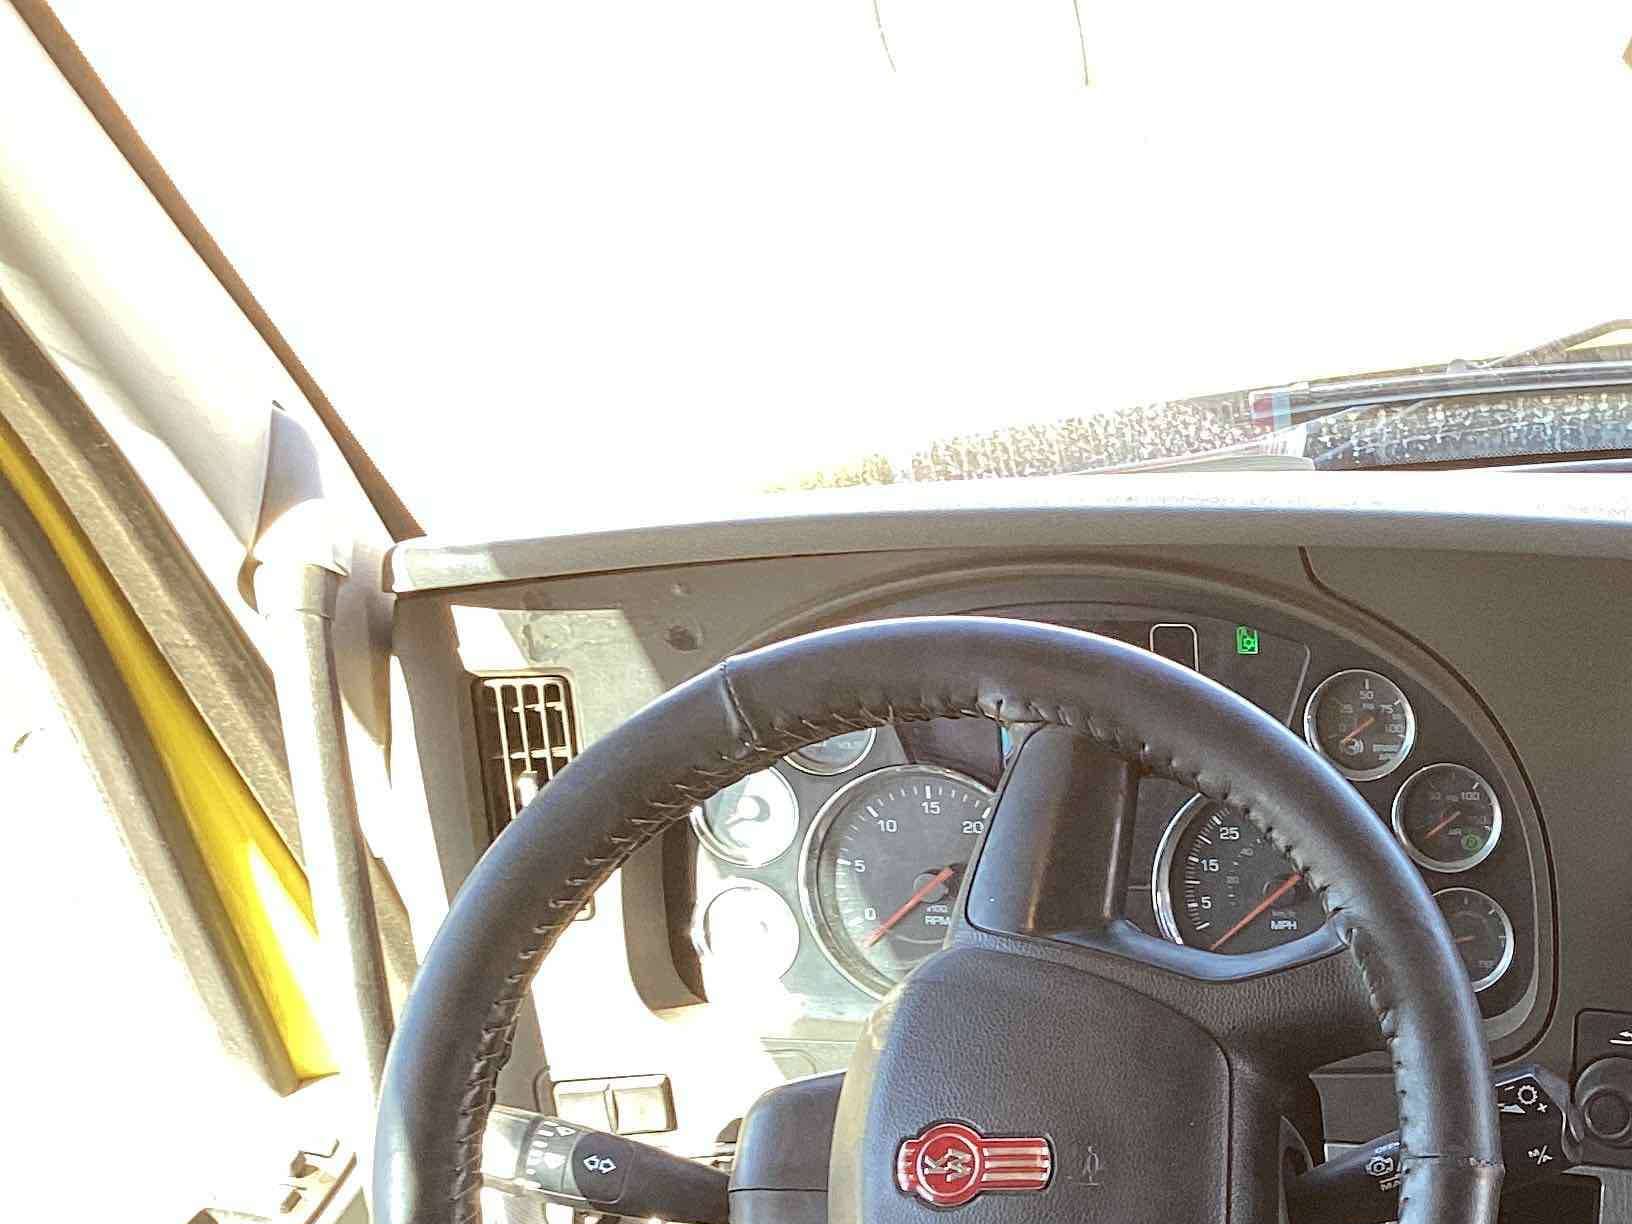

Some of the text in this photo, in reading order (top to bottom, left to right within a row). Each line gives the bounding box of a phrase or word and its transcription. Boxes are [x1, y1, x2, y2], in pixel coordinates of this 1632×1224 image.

[920, 801, 941, 815] 15
[878, 819, 898, 833] 10
[961, 820, 985, 834] 20
[1219, 827, 1240, 840] 25
[854, 860, 866, 873] 5
[1200, 859, 1220, 872] 15
[1201, 896, 1212, 909] 5
[864, 907, 877, 921] 0
[1270, 920, 1297, 930] MPH
